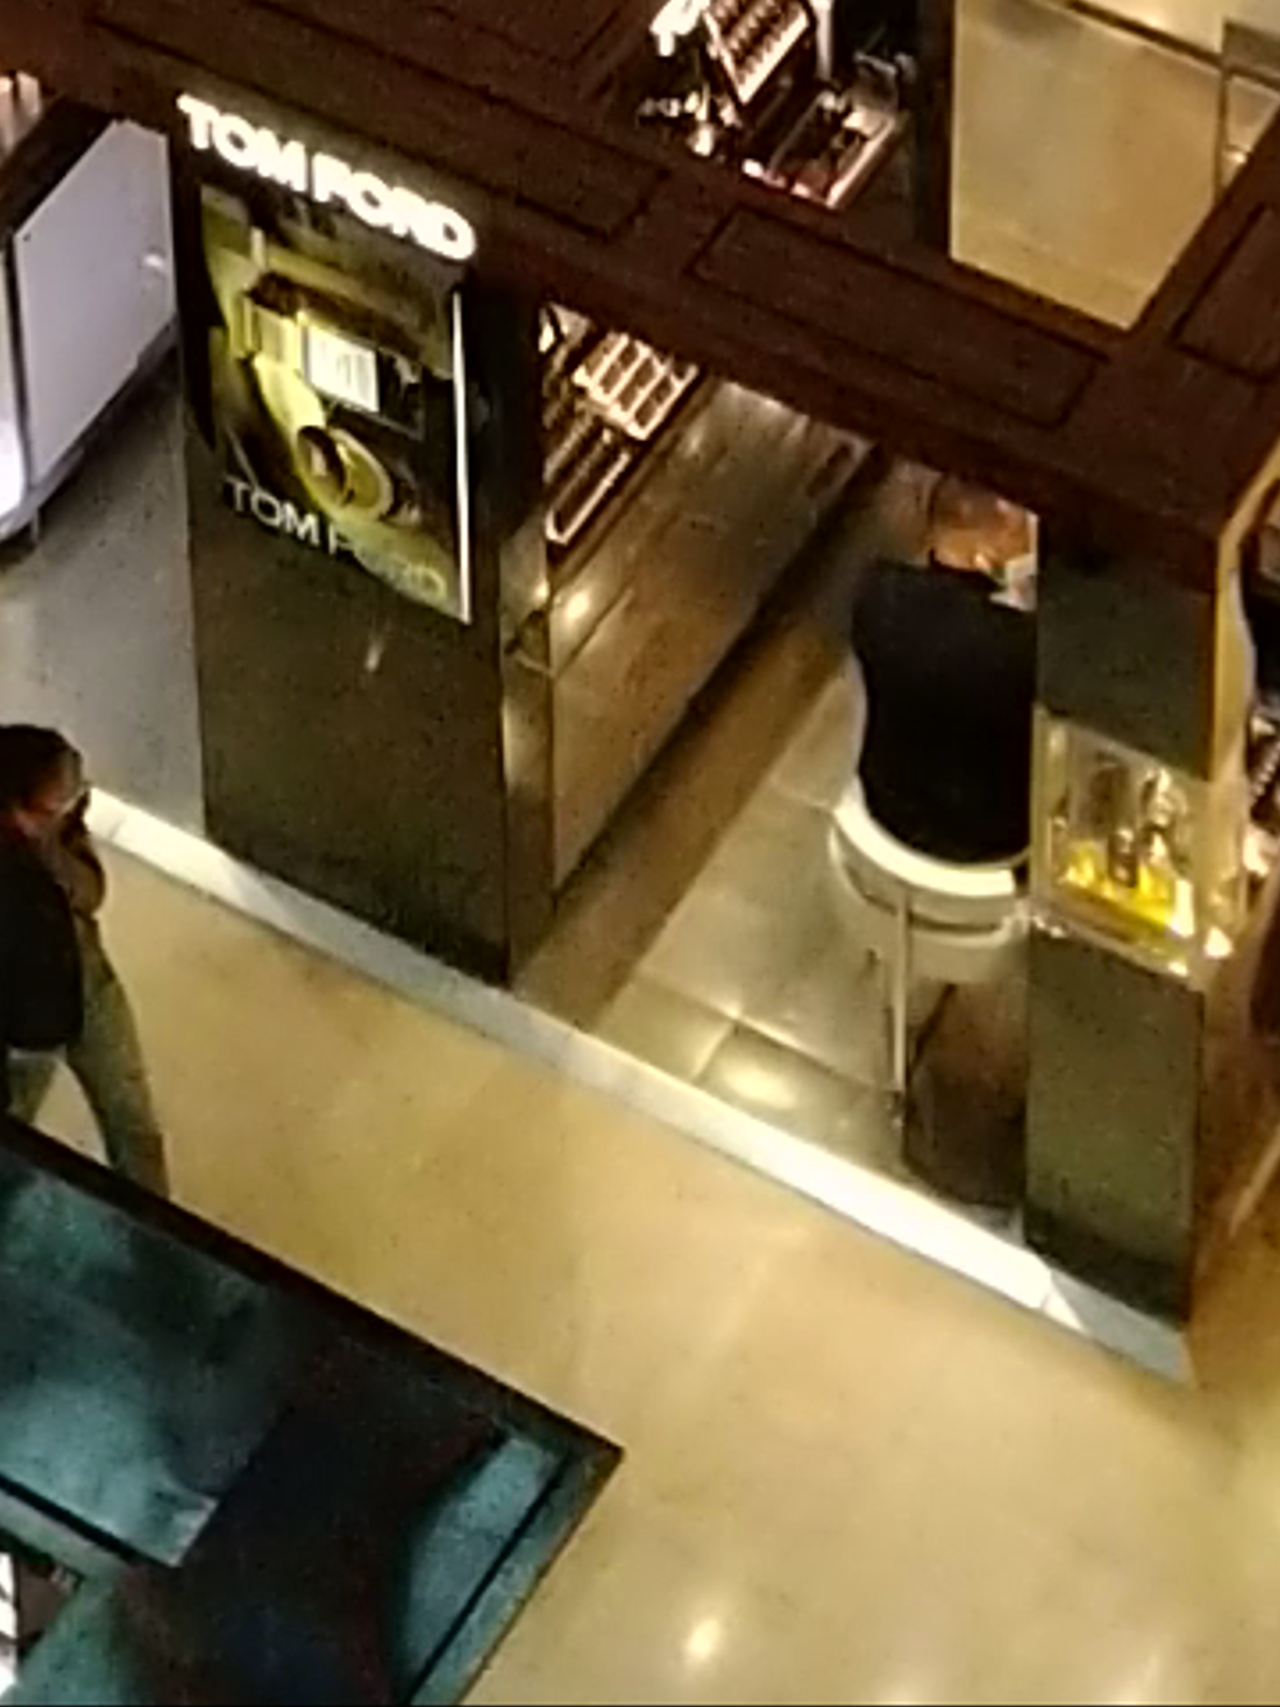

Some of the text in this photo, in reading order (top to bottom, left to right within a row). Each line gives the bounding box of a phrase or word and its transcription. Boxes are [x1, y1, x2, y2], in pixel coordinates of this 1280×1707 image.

[176, 94, 477, 260] TOM FORD
[224, 475, 320, 548] TOM
